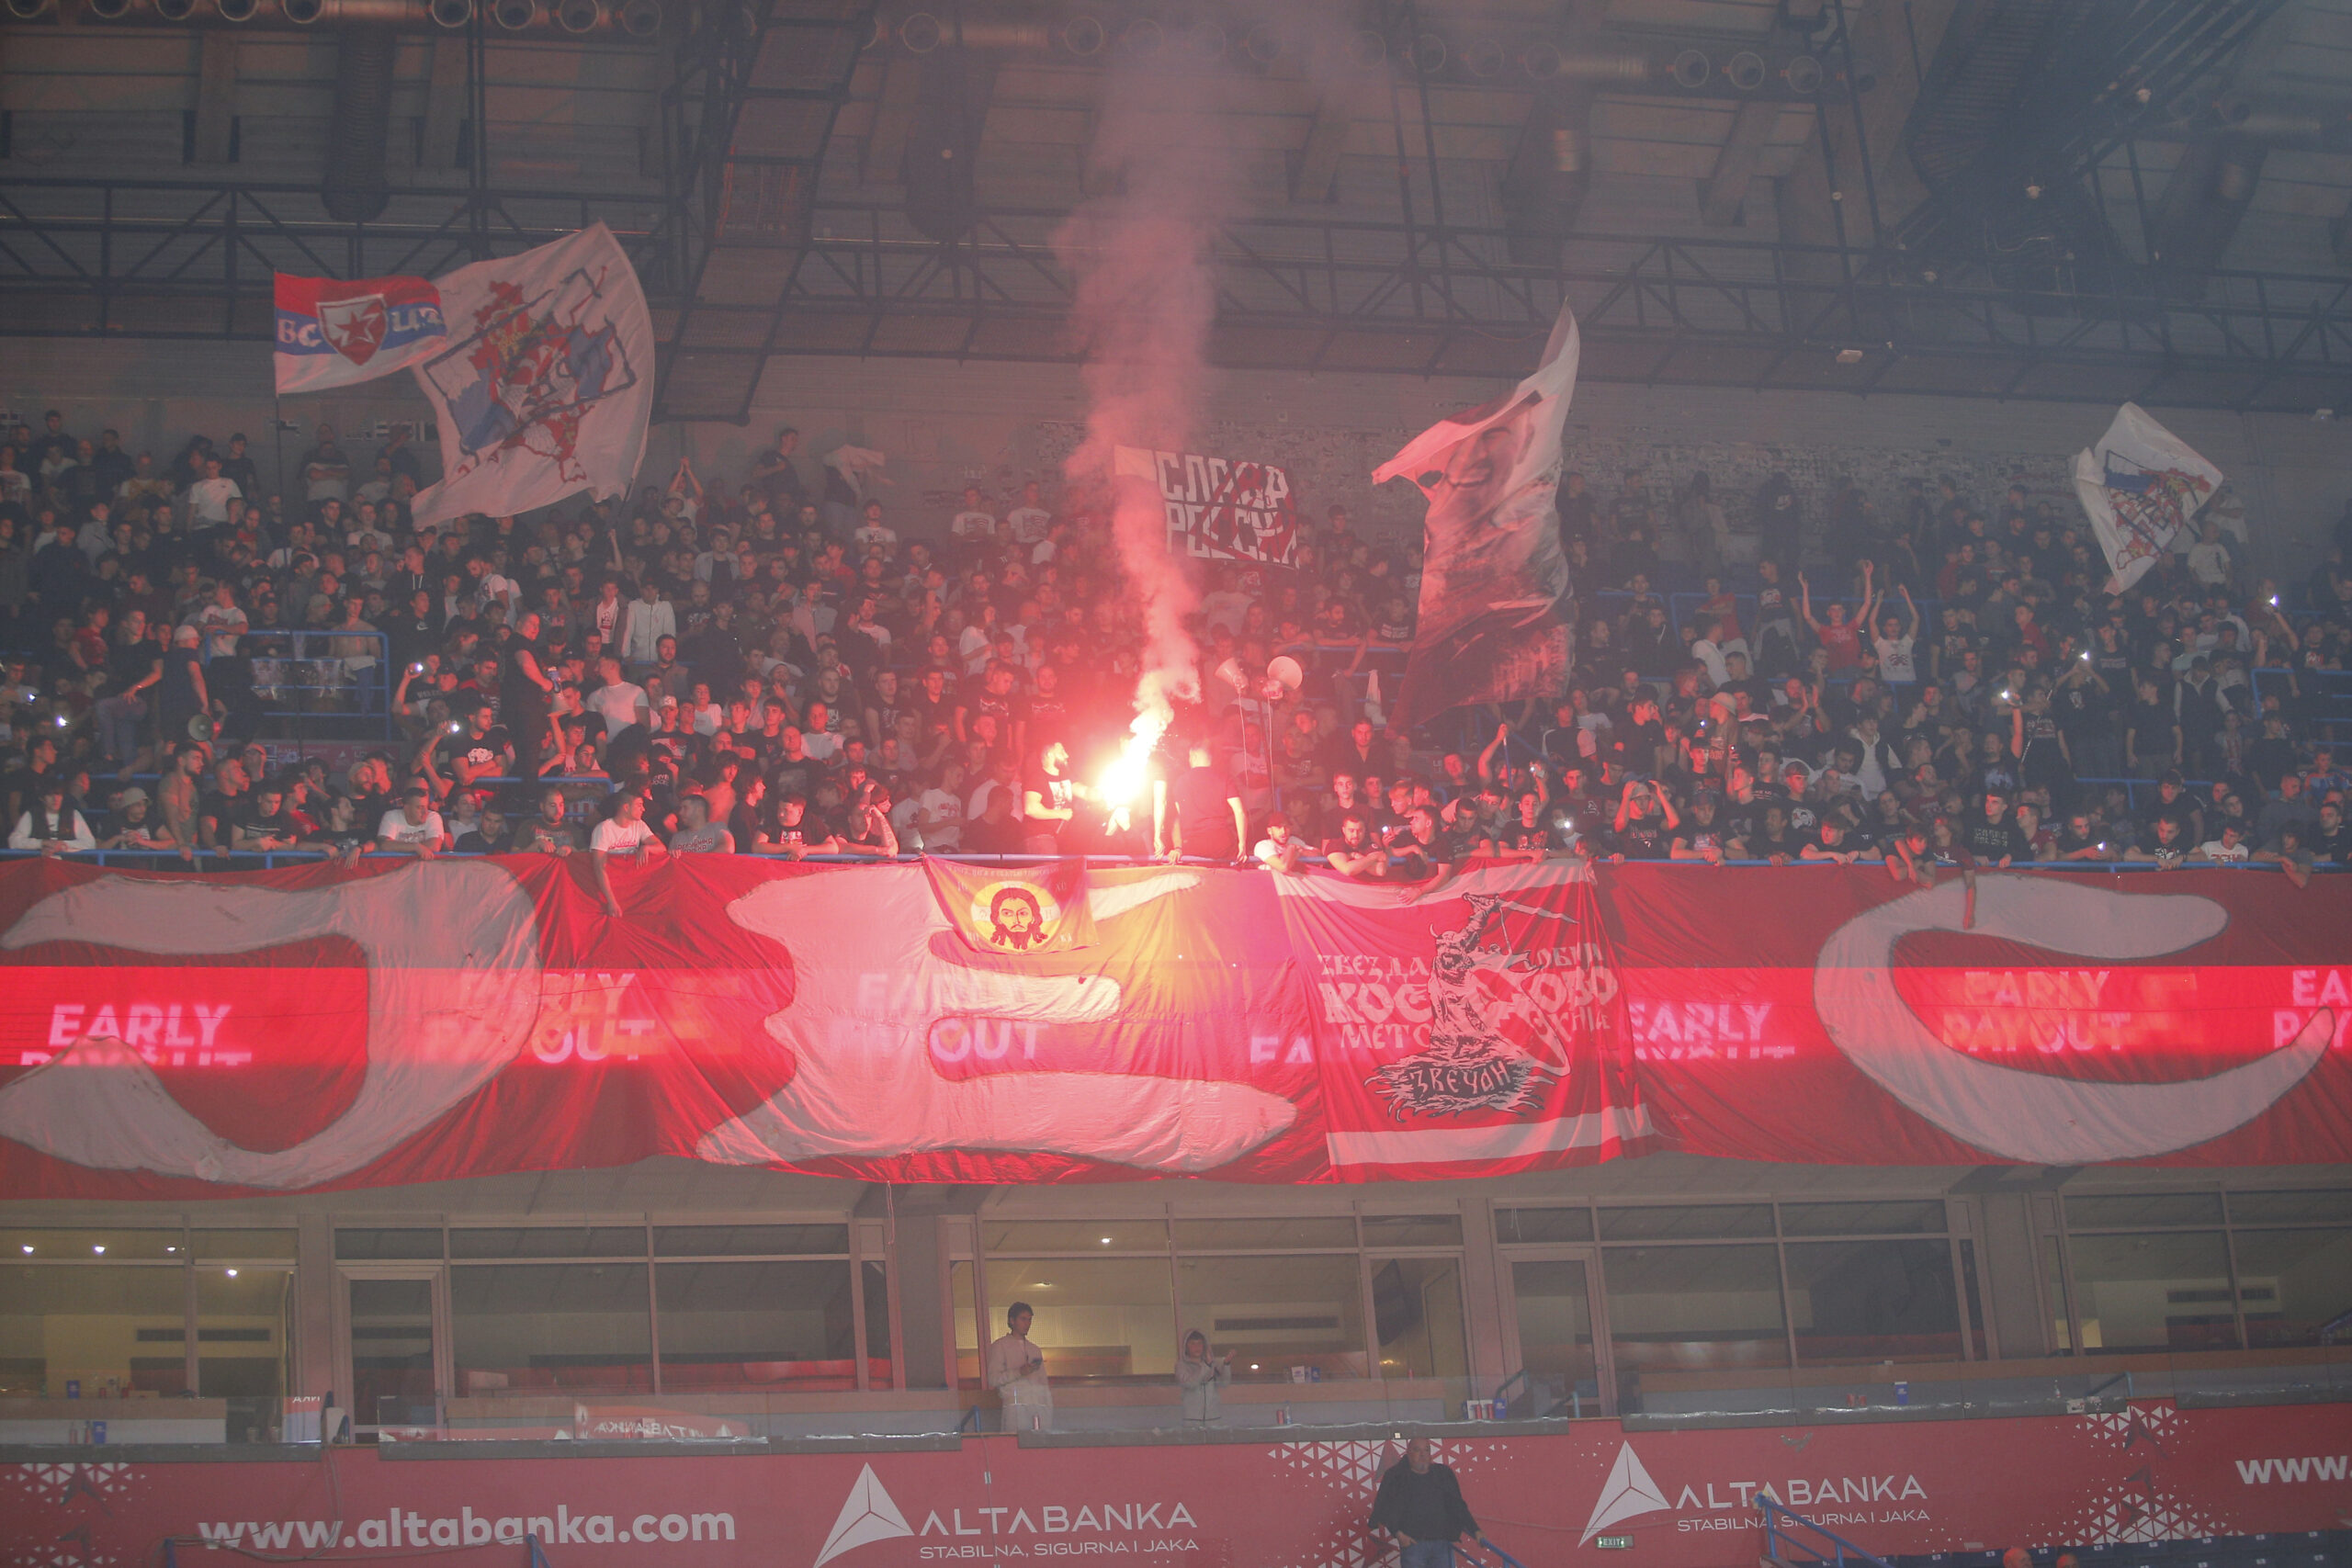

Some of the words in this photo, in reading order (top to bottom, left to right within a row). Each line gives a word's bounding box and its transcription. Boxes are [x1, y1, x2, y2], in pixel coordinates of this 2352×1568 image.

[1962, 970, 2111, 1010] EARLY
[49, 1004, 232, 1046] EARLY
[1941, 1012, 2132, 1055] PAYOUT
[2235, 1455, 2352, 1484] www
[1676, 1474, 1928, 1509] ALTABANKA
[198, 1505, 736, 1550] www.altabanka.com
[920, 1502, 1198, 1536] ALTABANKA
[1880, 1509, 1930, 1523] JAKA
[920, 1543, 1029, 1559] STABILNA,
[1034, 1540, 1129, 1556] SIGURNA
[1143, 1539, 1200, 1552] JAKA
[1602, 1537, 1621, 1547] EXIT
